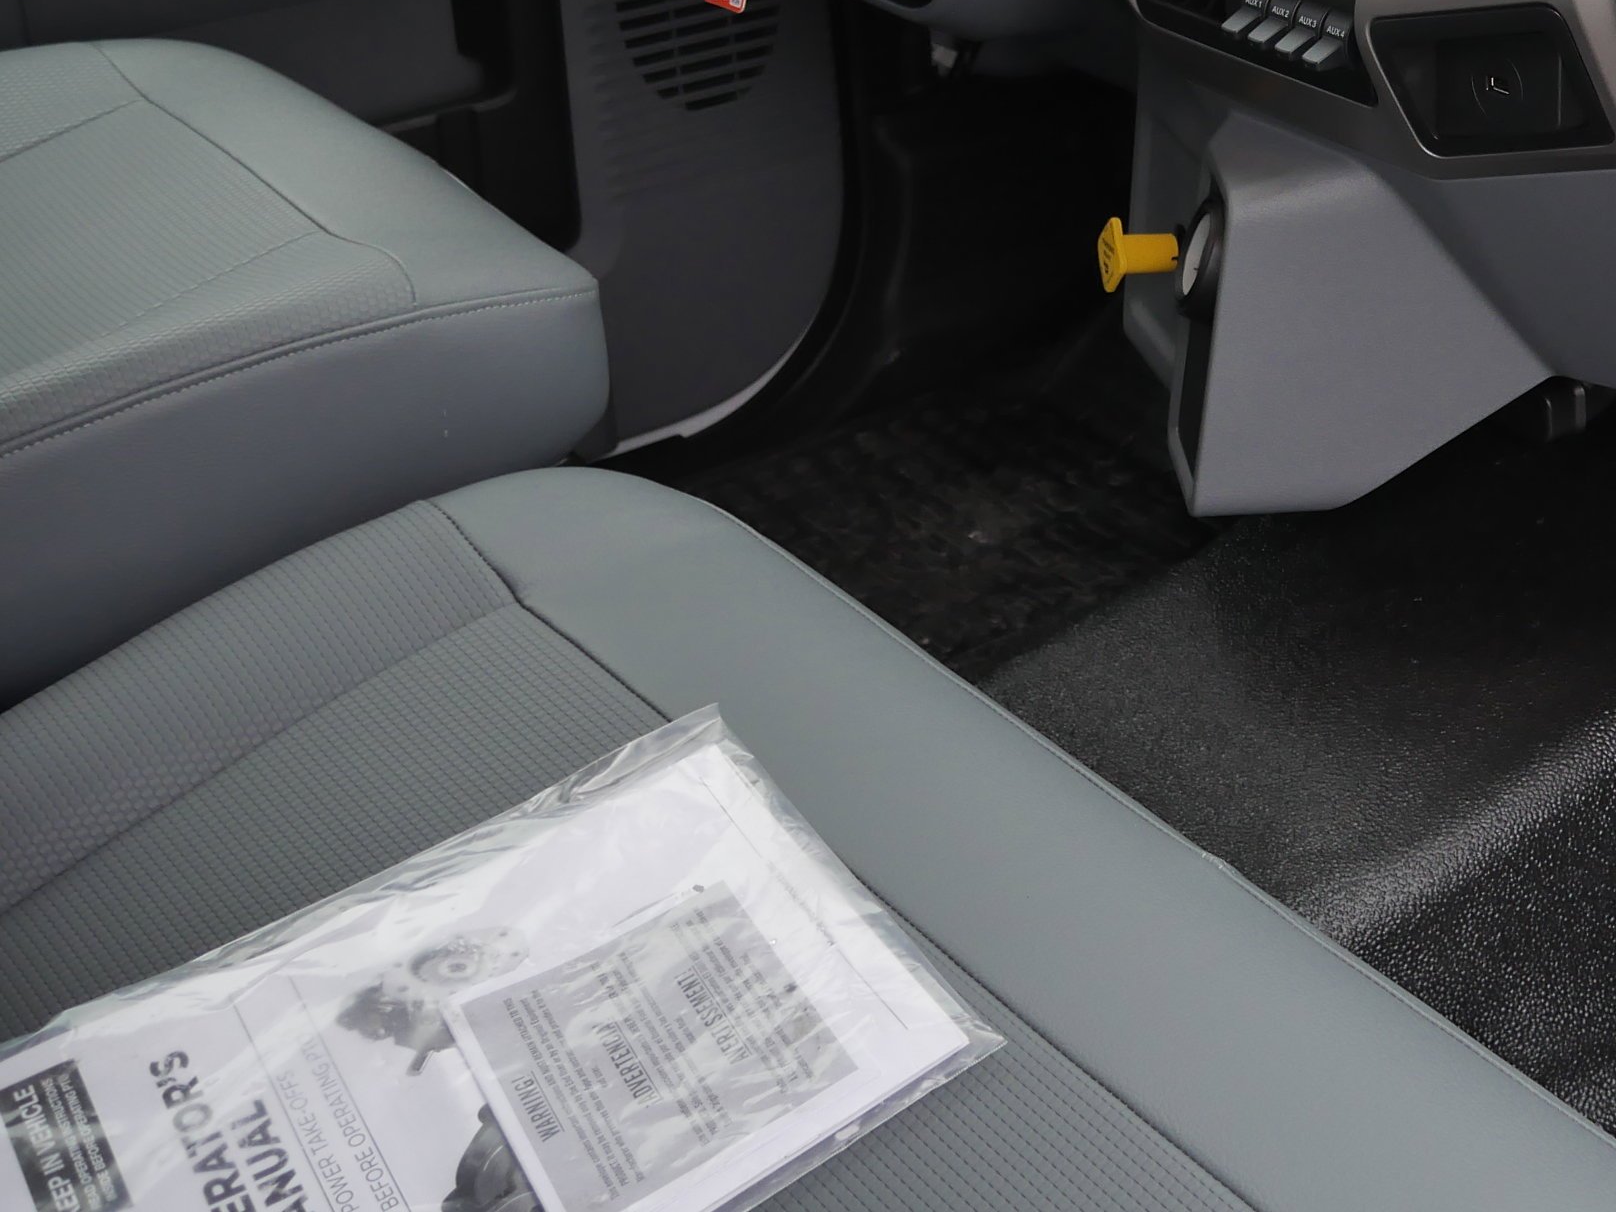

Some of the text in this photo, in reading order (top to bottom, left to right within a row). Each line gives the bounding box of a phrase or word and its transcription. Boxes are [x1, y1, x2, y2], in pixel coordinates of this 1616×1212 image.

[1272, 6, 1286, 17] AUX
[1298, 16, 1312, 27] AUX
[1327, 26, 1340, 36] AUX
[674, 967, 749, 1065] AVERTISSEMENT!
[561, 1074, 574, 1087] End
[574, 1067, 586, 1078] and
[10, 1083, 59, 1155] VEHICLE
[63, 1089, 92, 1136] OPERATING
[311, 1060, 367, 1149] OPERATING
[511, 1073, 560, 1140] WARNING!
[81, 1134, 106, 1171] BEFORE
[275, 1067, 359, 1212] POWER TAKE-OFFS
[38, 1151, 66, 1175] IN
[354, 1145, 400, 1212] BEFORE
